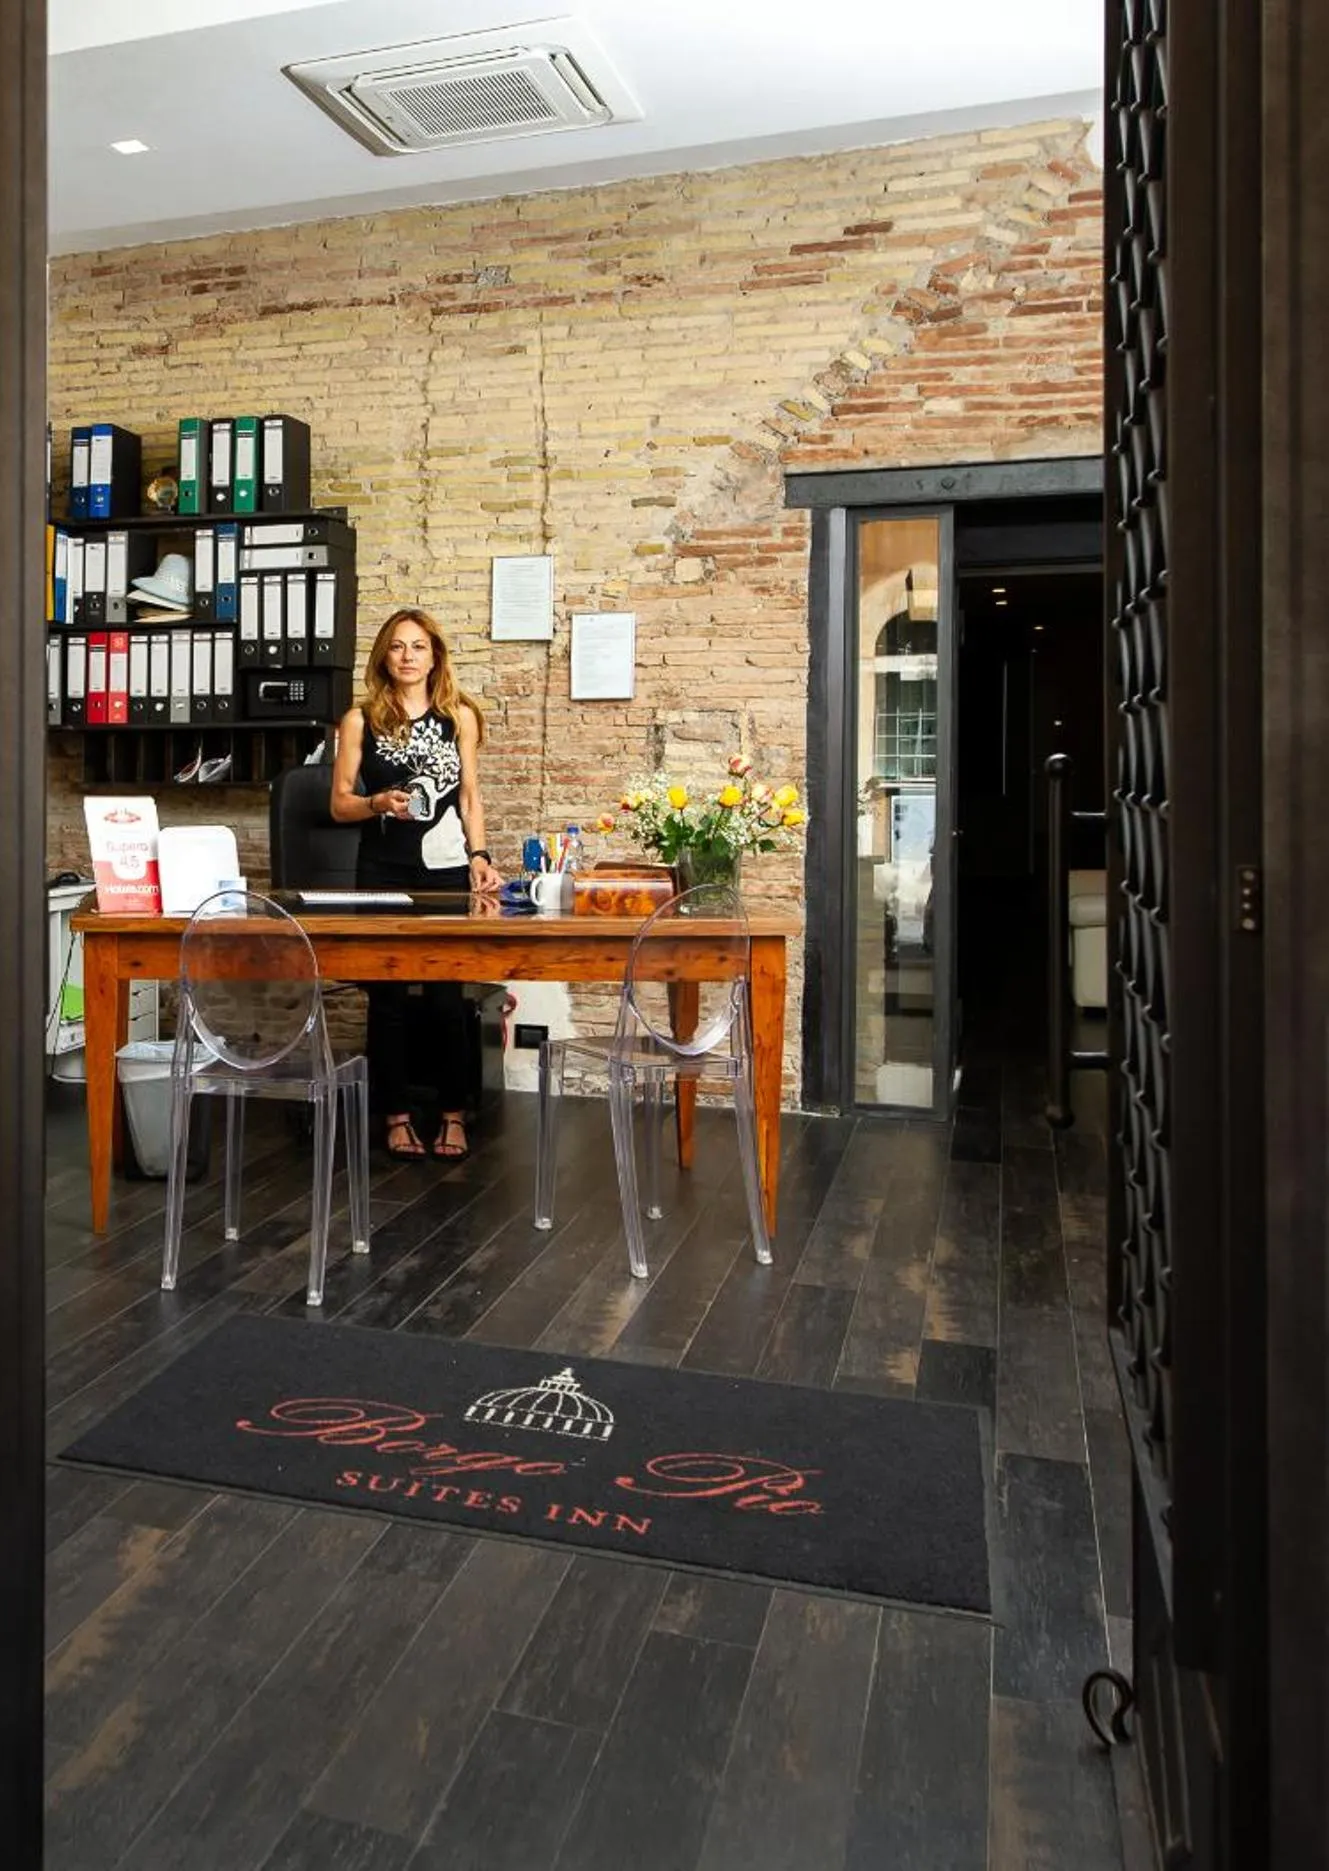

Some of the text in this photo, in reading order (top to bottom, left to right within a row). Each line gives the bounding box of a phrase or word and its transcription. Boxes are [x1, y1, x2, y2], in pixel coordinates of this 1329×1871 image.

[236, 1398, 825, 1515] Borgo Pio
[335, 1470, 653, 1536] SUITES INN
